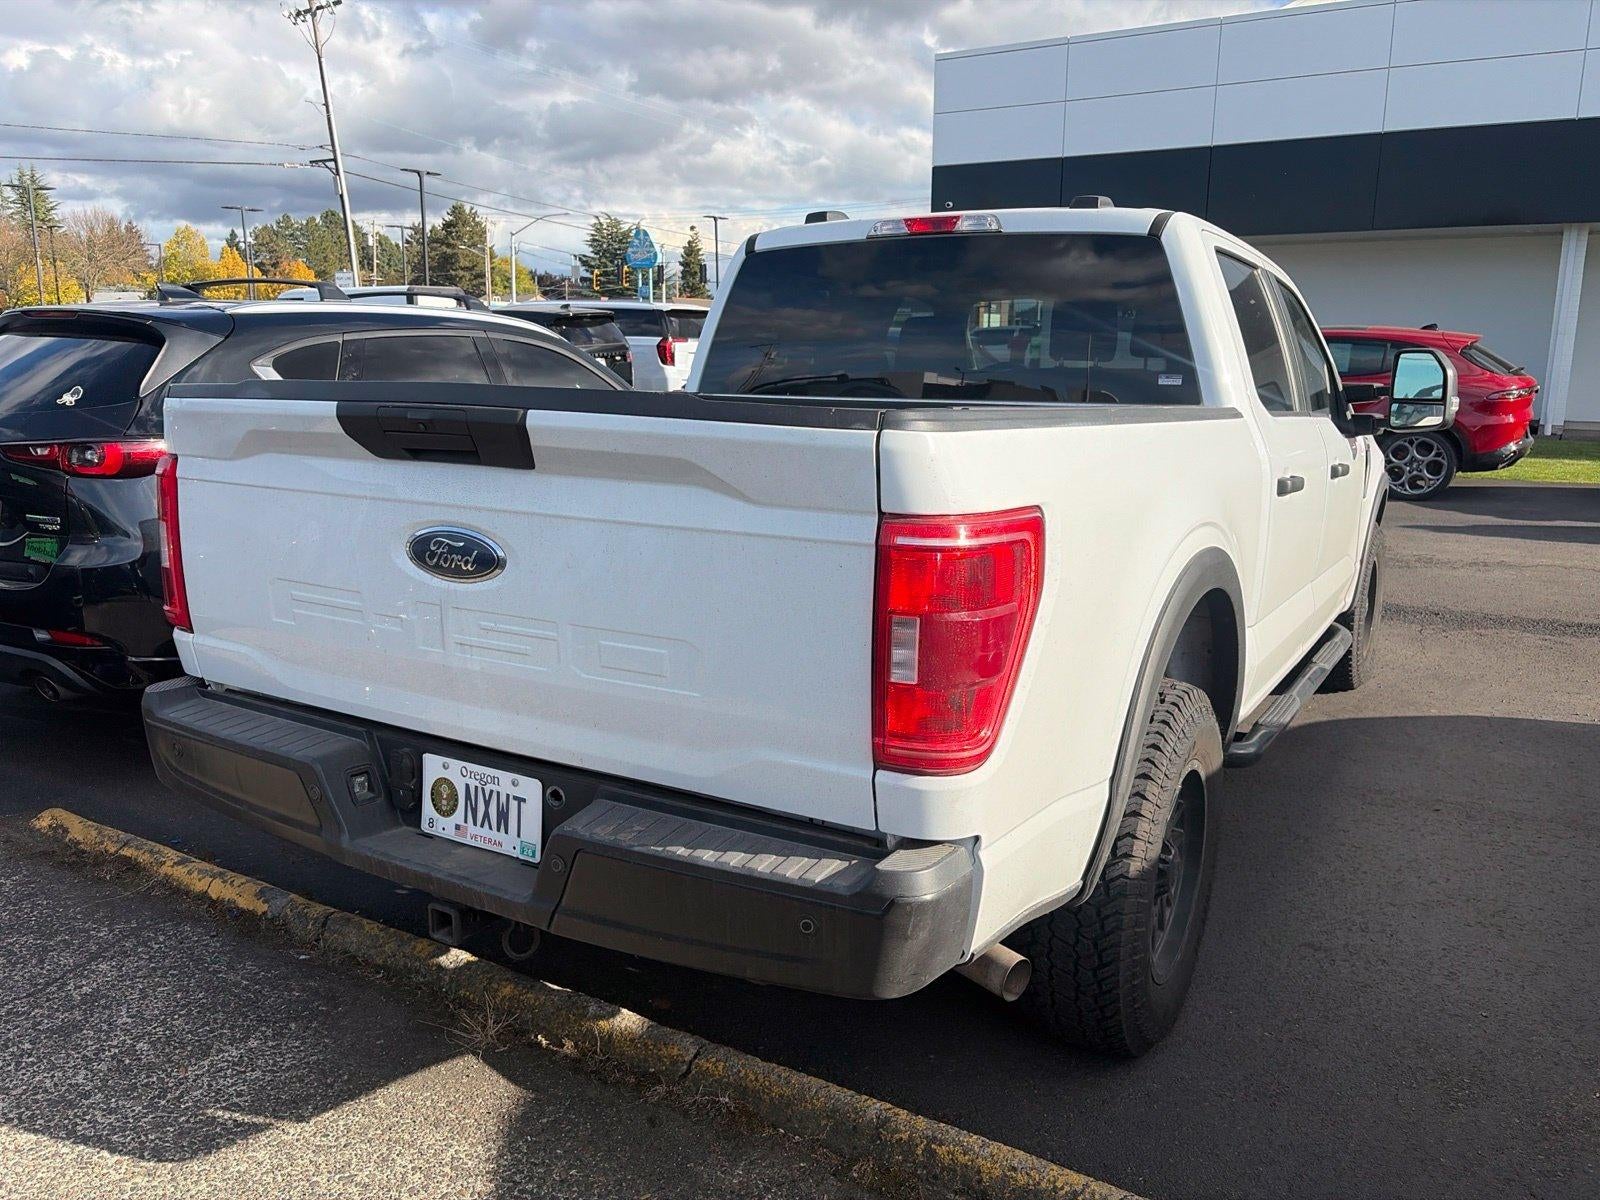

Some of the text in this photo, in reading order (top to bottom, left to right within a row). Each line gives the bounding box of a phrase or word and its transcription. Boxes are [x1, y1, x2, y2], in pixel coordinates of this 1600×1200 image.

[425, 537, 478, 571] Ford
[270, 577, 702, 698] F-150
[460, 765, 500, 787] Oregon
[427, 817, 435, 829] 8
[463, 782, 527, 838] NXWT
[469, 832, 504, 849] VETERAN
